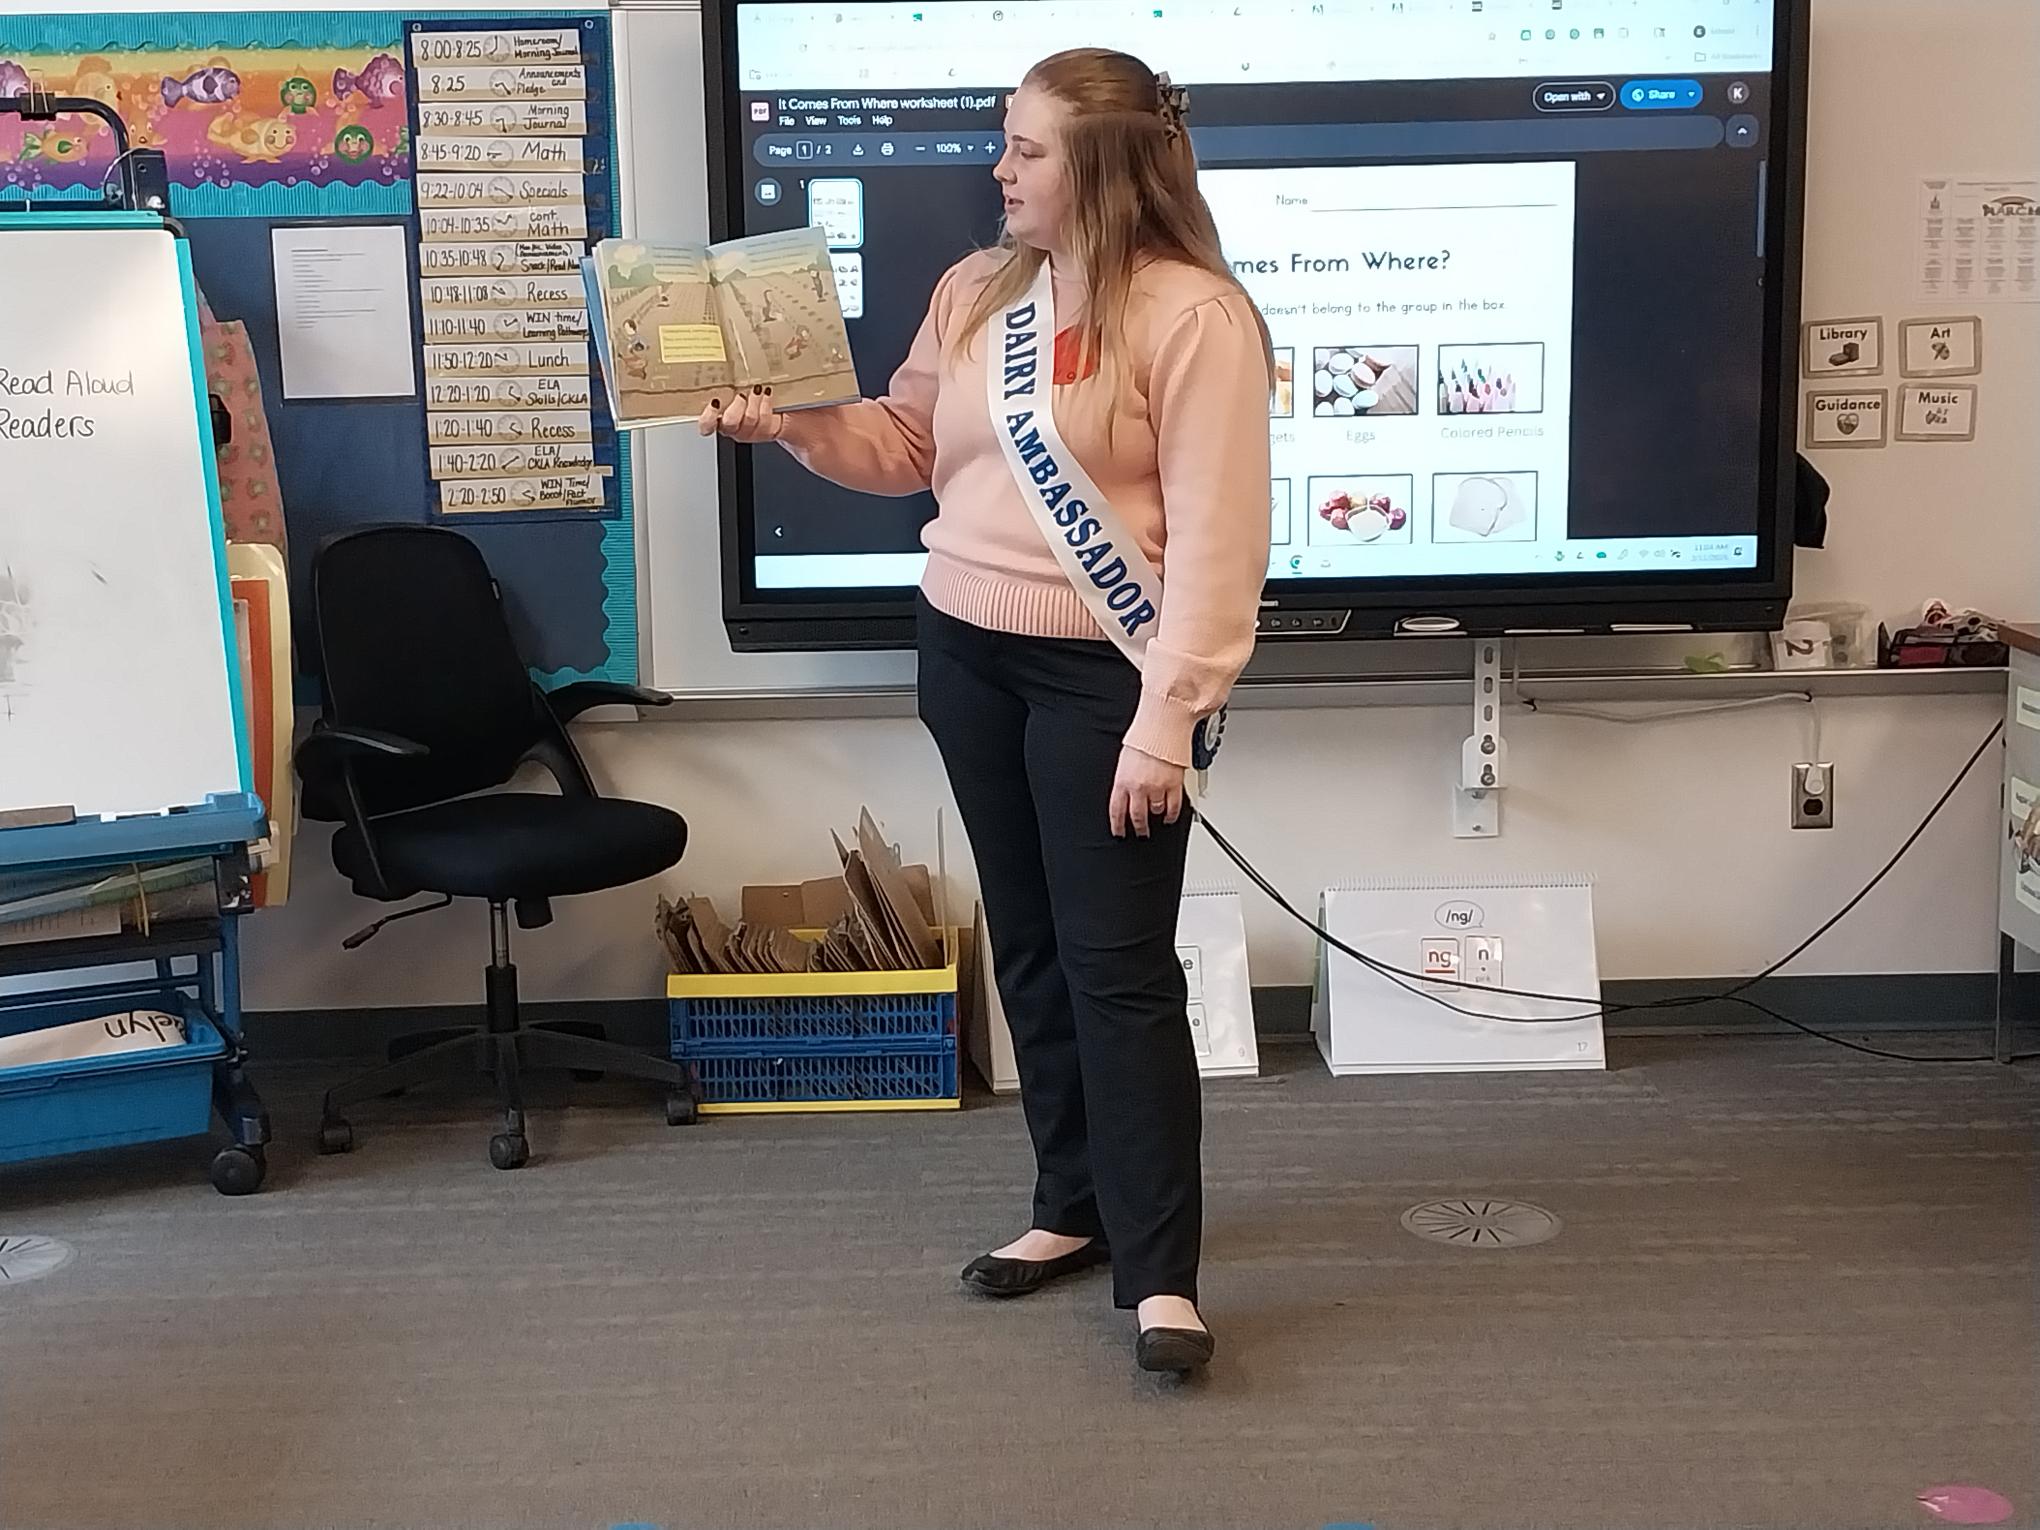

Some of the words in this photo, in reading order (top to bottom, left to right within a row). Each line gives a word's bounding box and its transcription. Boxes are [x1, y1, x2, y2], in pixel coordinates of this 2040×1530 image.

[514, 47, 552, 61] Morning
[1544, 91, 1569, 103] Open
[1570, 90, 1591, 102] with
[1648, 89, 1676, 100] Share
[1733, 87, 1743, 100] K
[778, 97, 788, 111] It
[788, 97, 829, 111] Comes
[830, 97, 861, 110] From
[861, 96, 899, 110] Where
[900, 95, 959, 110] worksheet
[528, 104, 570, 121] Morning
[753, 107, 769, 116] PDF
[522, 115, 568, 131] Journal
[779, 115, 796, 128] File
[805, 115, 828, 127] View
[837, 115, 862, 126] Tools
[872, 115, 894, 128] Help
[521, 140, 568, 163] Math
[769, 145, 792, 158] Page
[936, 142, 962, 154] 100%
[519, 180, 569, 202] Specials
[1276, 194, 1308, 206] Name
[527, 221, 569, 239] Math
[1231, 258, 1280, 274] mes
[1291, 253, 1350, 273] From
[1361, 248, 1451, 271] Where?
[527, 281, 568, 301] Recess
[1261, 302, 1306, 316] doesn't
[1312, 302, 1352, 317] belong
[1358, 302, 1371, 314] to
[1377, 301, 1397, 313] the
[1401, 301, 1438, 316] group
[1442, 300, 1453, 312] in
[1458, 299, 1478, 312] the
[526, 311, 551, 324] WIN
[1819, 327, 1868, 342] Library
[1930, 327, 1952, 339] Art
[1004, 301, 1038, 400] DAIRY
[529, 348, 570, 369] Lunch
[0, 368, 54, 396] Read
[66, 370, 135, 396] Aloud
[538, 378, 561, 391] ELA
[1815, 399, 1881, 412] Guidance
[1918, 392, 1959, 405] Music
[0, 408, 95, 439] Readers
[531, 416, 576, 439] Recess
[1346, 430, 1376, 444] Eggs
[1440, 427, 1493, 439] Colored
[541, 477, 563, 489] WIN
[1006, 410, 1156, 638] AMBASSADOR
[1445, 908, 1474, 926] /ng/
[1183, 959, 1194, 971] e
[1428, 950, 1452, 968] ng
[1478, 949, 1489, 961] n
[1577, 1042, 1588, 1052] 17
